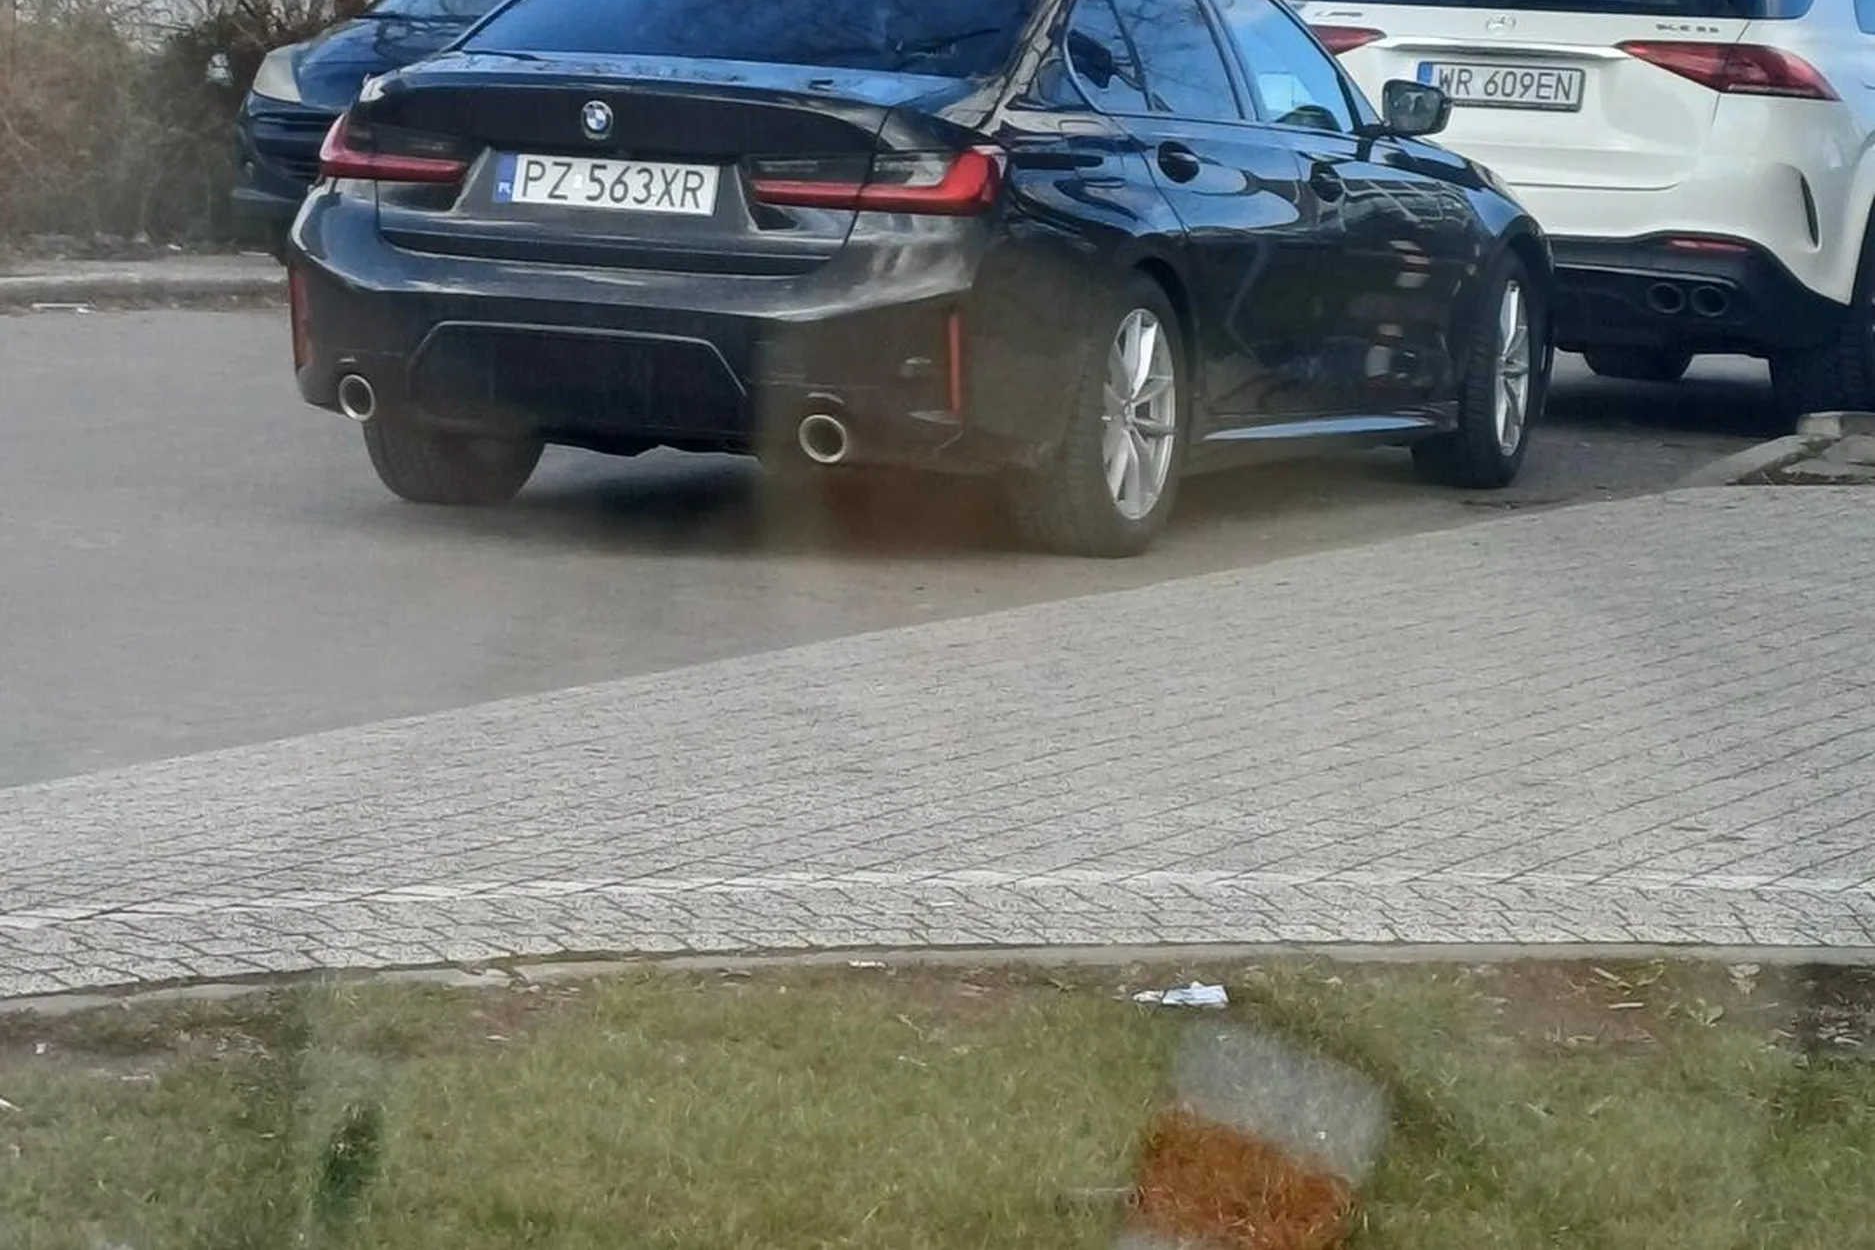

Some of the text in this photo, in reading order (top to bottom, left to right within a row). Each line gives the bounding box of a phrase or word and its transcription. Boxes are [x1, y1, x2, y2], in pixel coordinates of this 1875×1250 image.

[1439, 68, 1573, 101] WR 609EN
[522, 160, 705, 209] PZ 563XR
